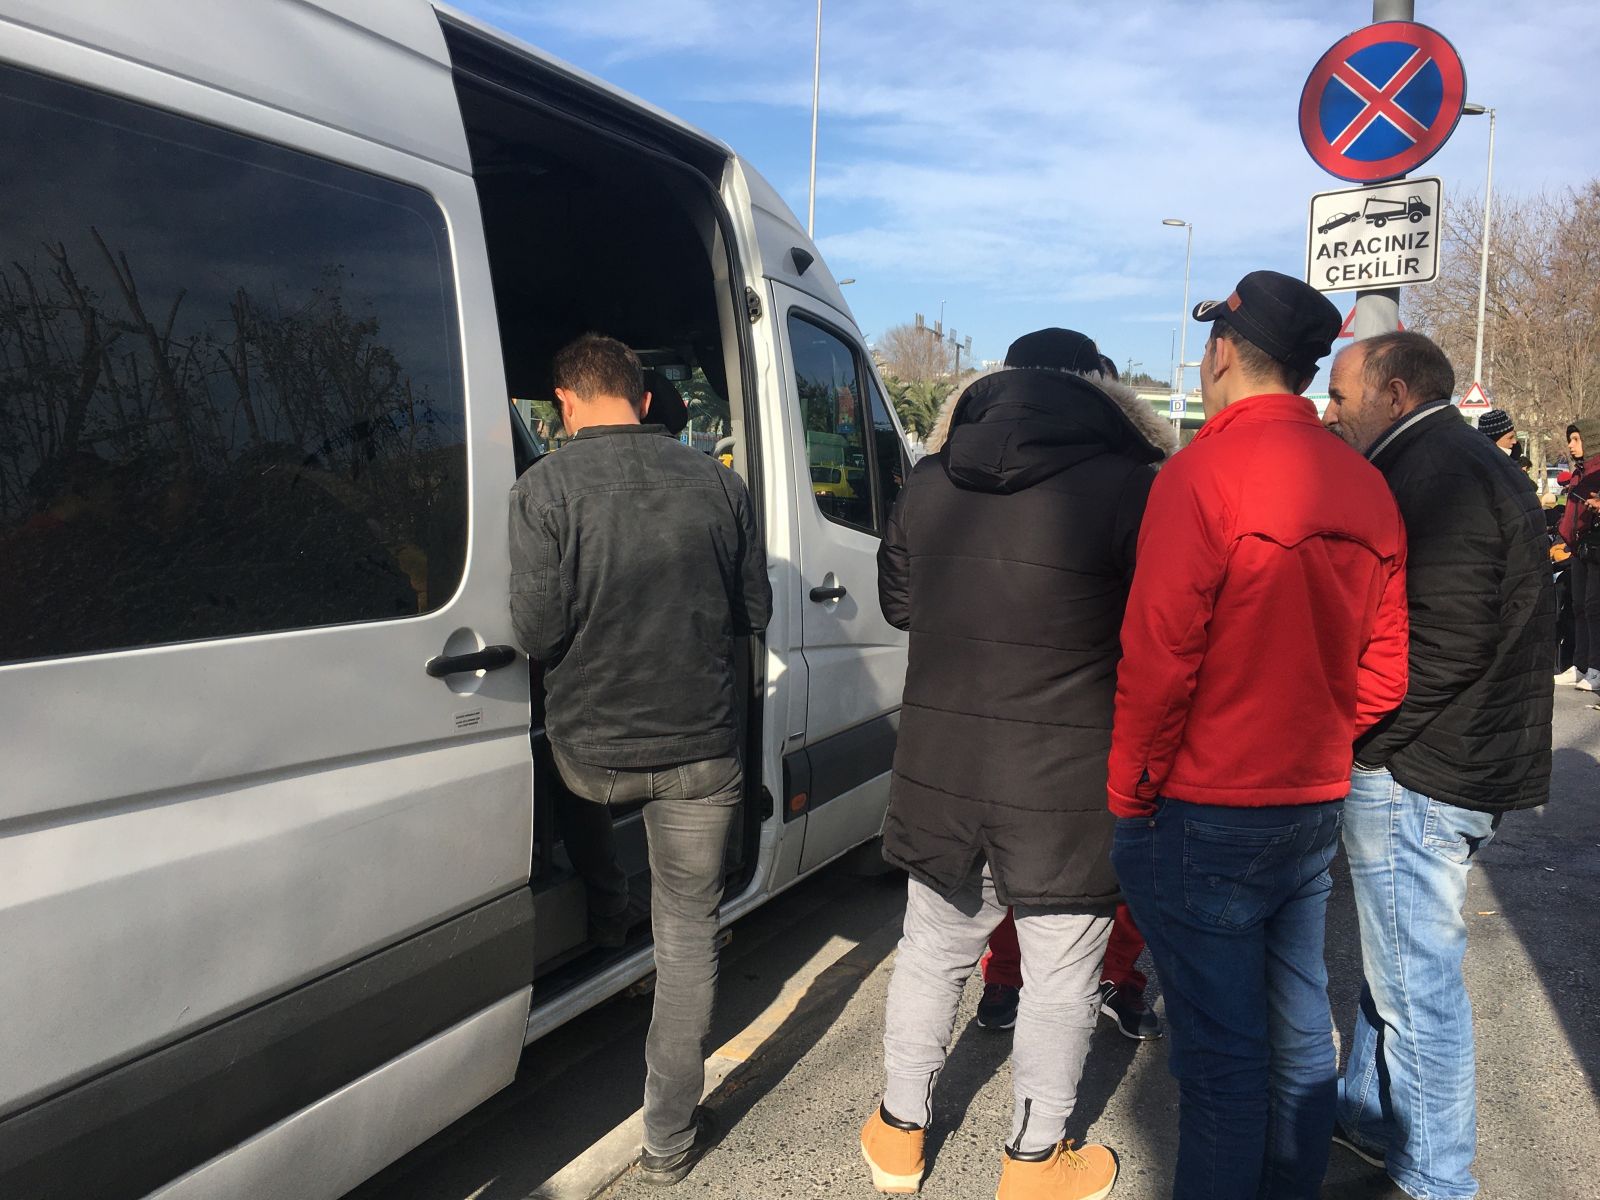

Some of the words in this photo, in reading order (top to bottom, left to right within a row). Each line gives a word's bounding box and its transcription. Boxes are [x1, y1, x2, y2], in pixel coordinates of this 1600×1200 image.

[1316, 231, 1430, 260] ARACINIZ
[1325, 255, 1420, 287] ÇEKİLİR
[1174, 401, 1182, 410] D
